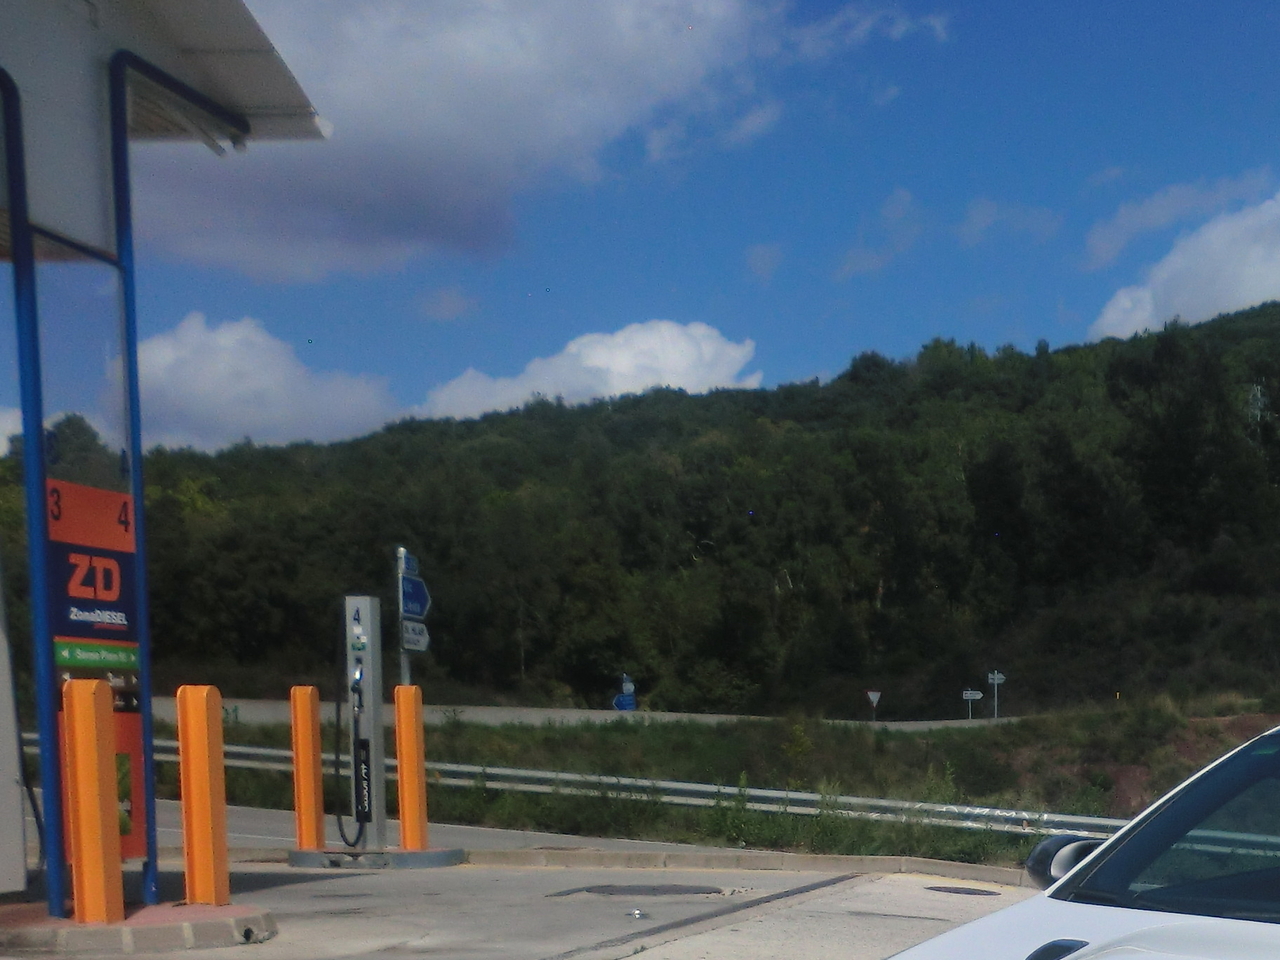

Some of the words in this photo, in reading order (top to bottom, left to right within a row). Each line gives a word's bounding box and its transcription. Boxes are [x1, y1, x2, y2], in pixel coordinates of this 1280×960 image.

[50, 487, 61, 521] 3
[118, 501, 131, 533] 4
[67, 552, 121, 602] ZD
[352, 606, 361, 625] 4
